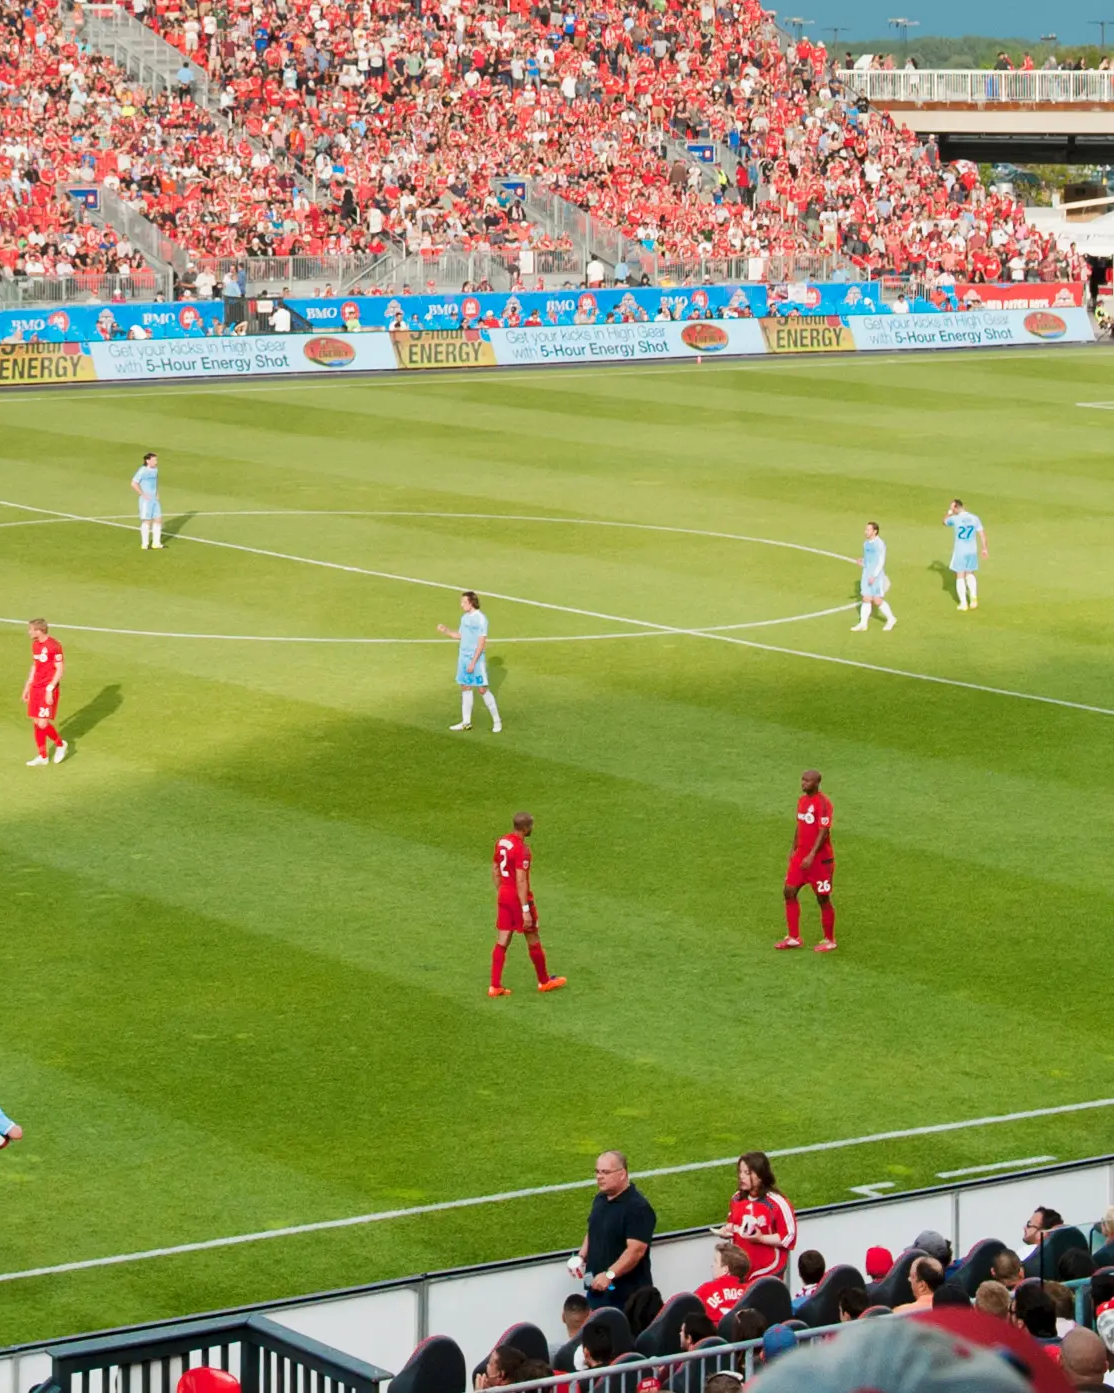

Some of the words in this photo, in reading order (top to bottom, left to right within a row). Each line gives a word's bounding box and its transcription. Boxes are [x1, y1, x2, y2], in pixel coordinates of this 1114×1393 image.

[306, 307, 336, 319] BMO
[12, 319, 45, 331] BMO
[870, 331, 893, 346] with
[895, 329, 937, 344] 5-Hour
[941, 327, 982, 345] Energy
[985, 325, 1013, 341] Shot
[506, 330, 527, 344] Get
[531, 329, 557, 347] your
[560, 327, 591, 343] kicks
[593, 327, 602, 341] in
[607, 326, 633, 343] High
[635, 325, 665, 339] Gear
[776, 327, 842, 348] ENERGY
[109, 344, 132, 358] Get
[137, 344, 166, 361] your
[170, 340, 203, 356] kicks
[206, 339, 217, 354] in
[221, 339, 251, 357] High
[255, 339, 286, 353] Gear
[408, 341, 483, 365] ENERGY
[512, 345, 538, 360] with
[541, 343, 587, 358] 5-Hour
[591, 341, 636, 358] Energy
[638, 339, 670, 354] Shot
[0, 356, 82, 381] ENERGY
[115, 359, 142, 374] with
[146, 358, 196, 372] 5-Hour
[202, 355, 251, 372] Energy
[256, 353, 290, 368] Shot
[958, 525, 974, 540] 27
[816, 879, 830, 893] 26
[707, 1292, 723, 1309] DE
